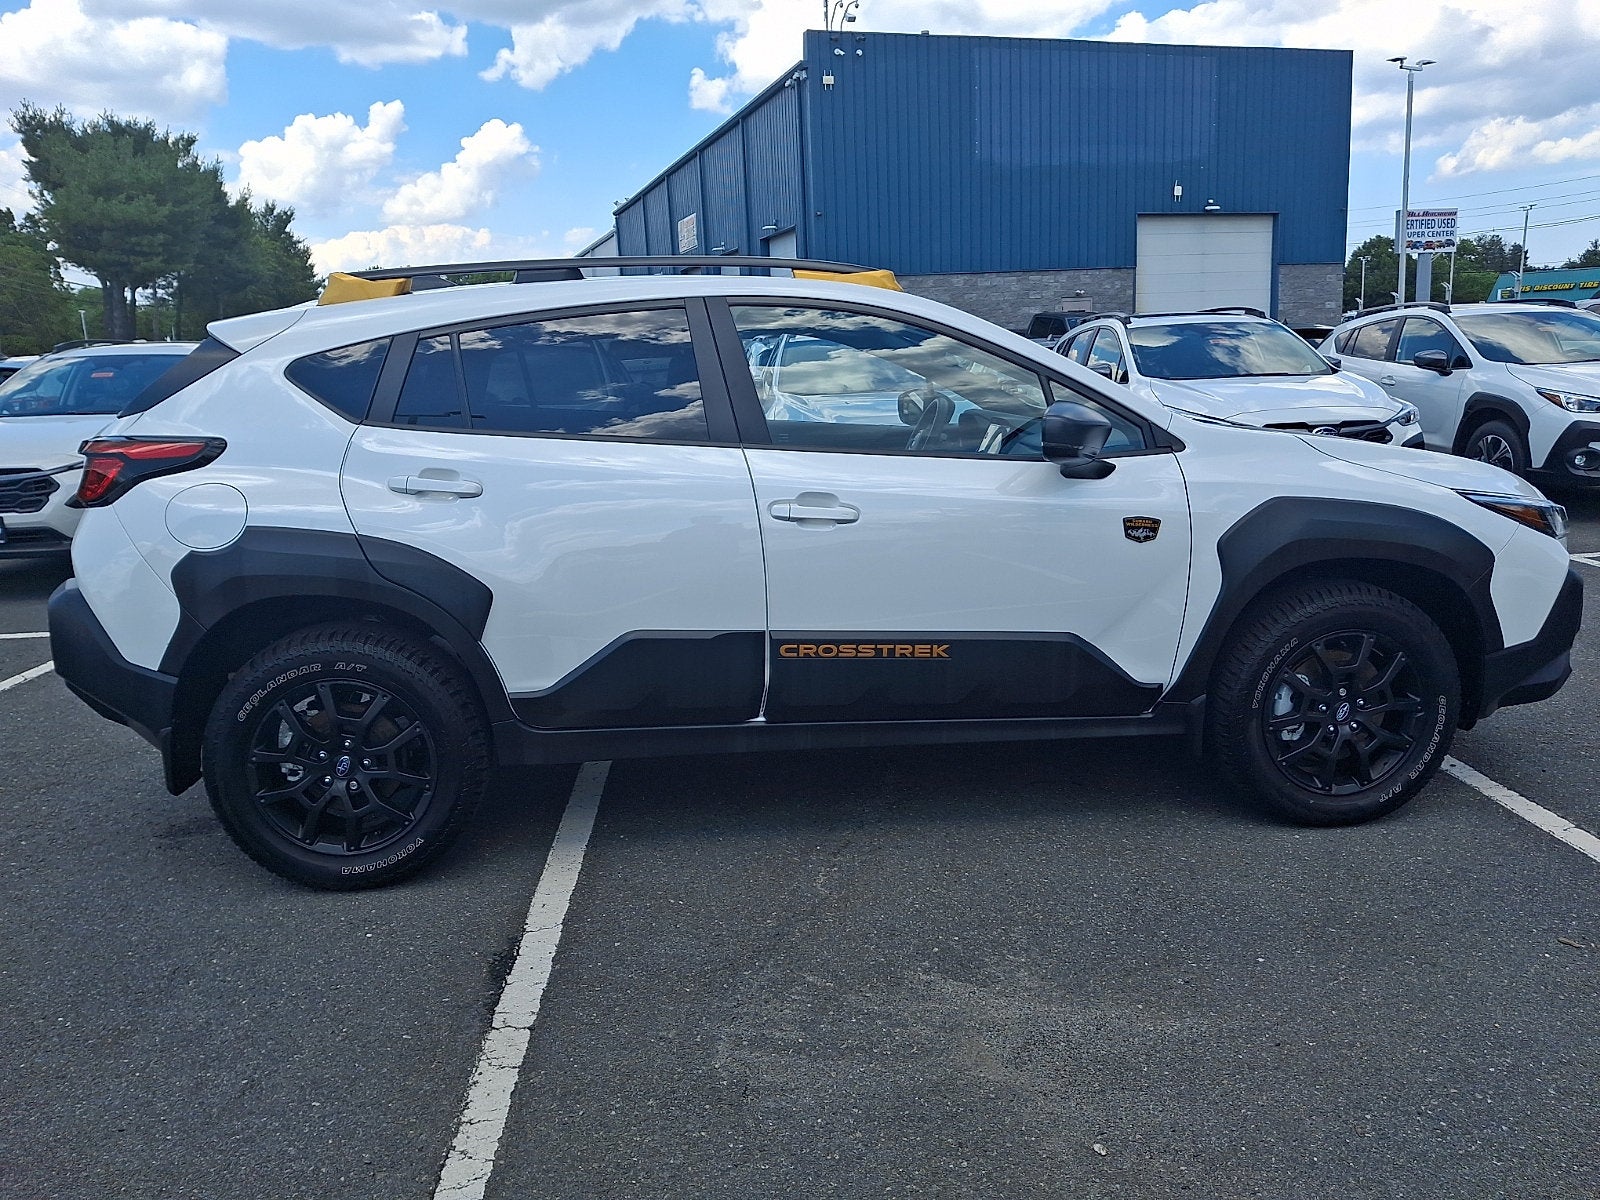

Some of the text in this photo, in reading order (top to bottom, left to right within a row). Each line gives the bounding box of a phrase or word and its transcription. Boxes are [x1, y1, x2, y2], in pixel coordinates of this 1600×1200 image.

[1406, 218, 1456, 230] ERTIFIED USED
[1534, 283, 1575, 291] DISCOUNT
[779, 644, 950, 657] CROSSTREK
[237, 661, 367, 722] GEOLANDAR A/T
[1252, 637, 1299, 709] YOKOHAMA
[1379, 695, 1447, 803] GEOLANDAR A/T
[341, 837, 425, 875] YOKOHAMA
